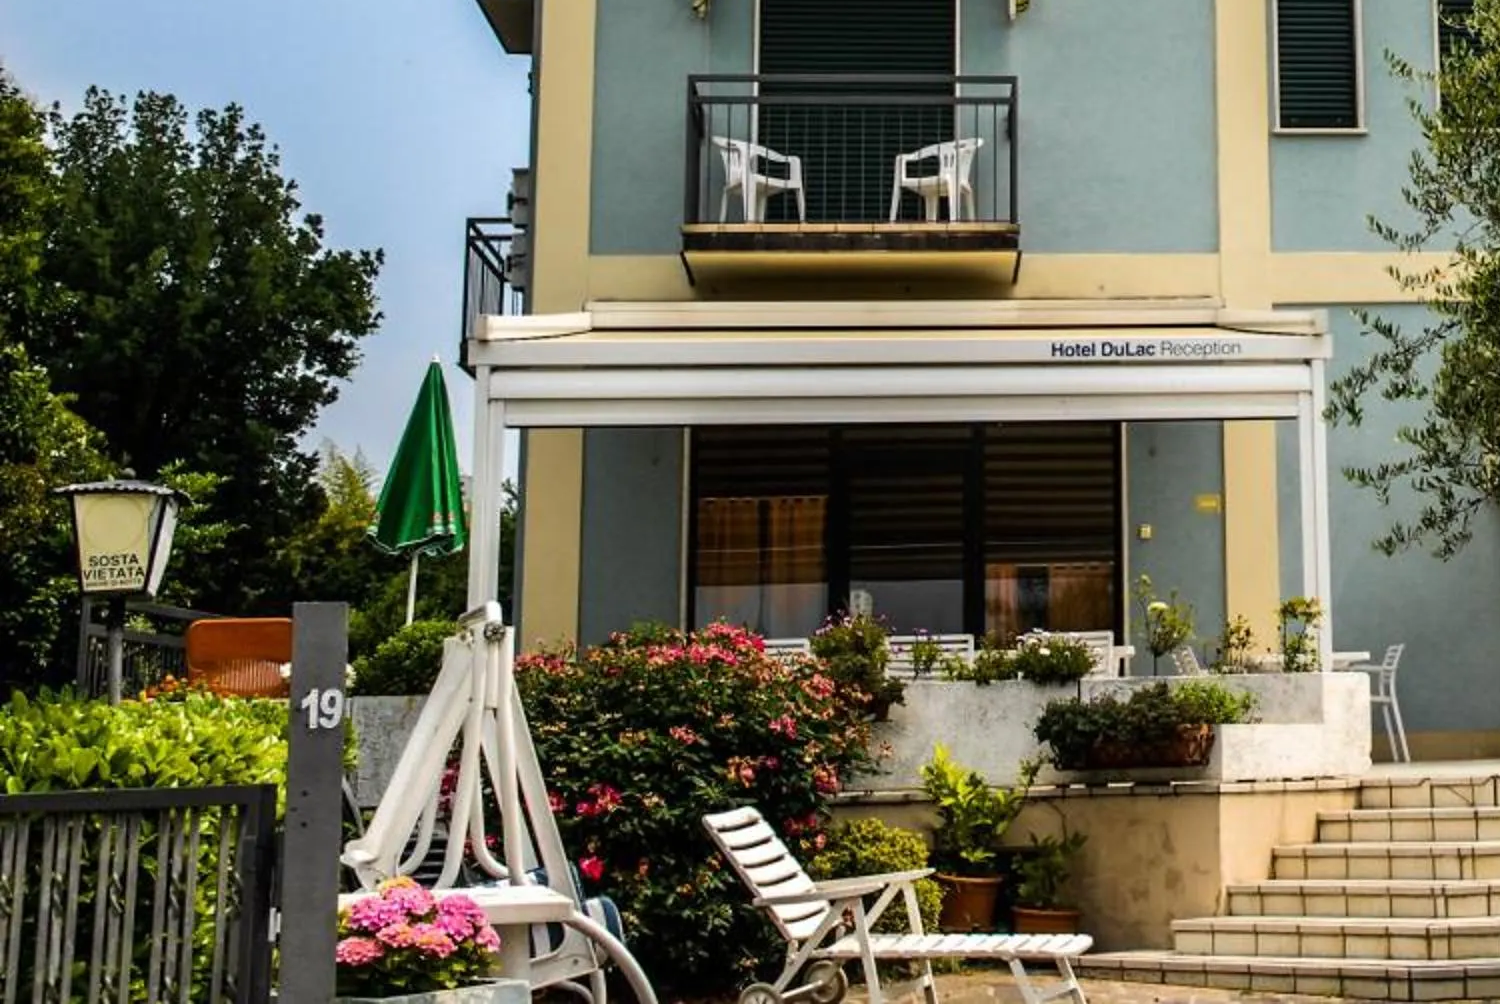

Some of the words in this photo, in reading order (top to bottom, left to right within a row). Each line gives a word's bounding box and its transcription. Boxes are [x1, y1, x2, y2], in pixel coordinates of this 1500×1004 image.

[1051, 341, 1096, 357] Hotel
[1101, 341, 1156, 357] DuLac
[1160, 339, 1242, 359] Reception
[88, 553, 139, 567] SOSTA
[83, 566, 145, 581] VIETATA
[301, 688, 344, 729] 19
